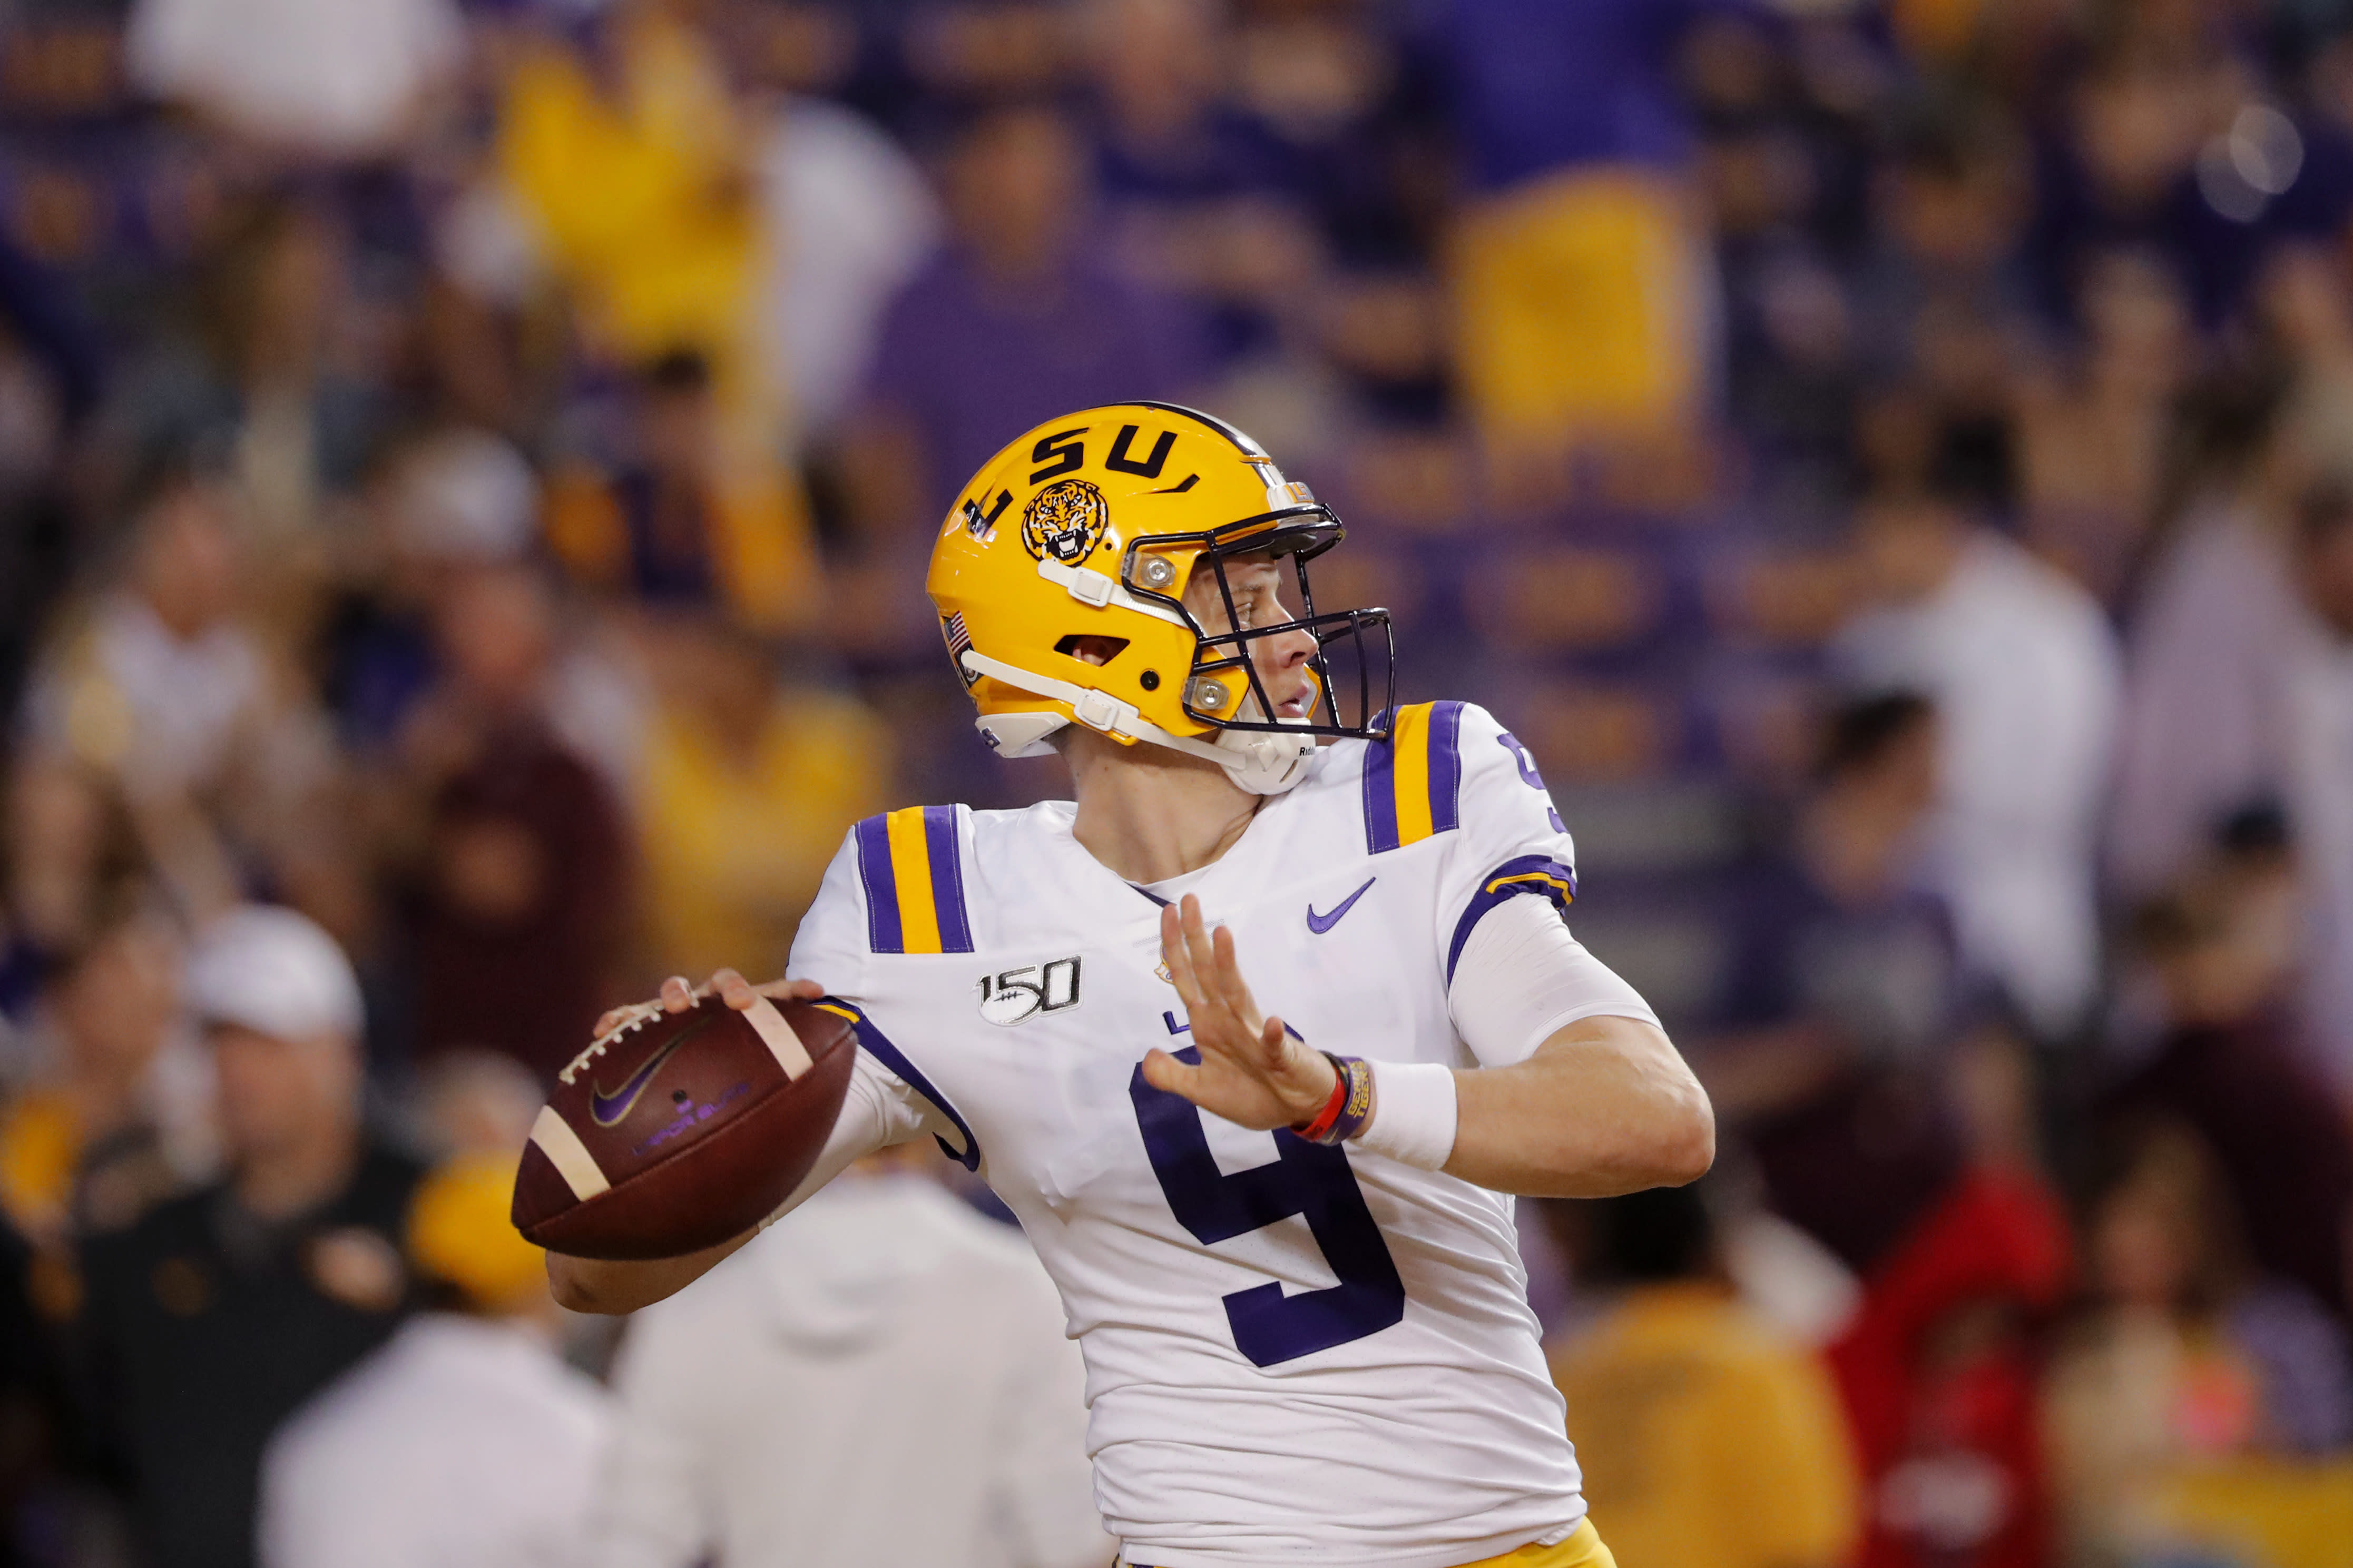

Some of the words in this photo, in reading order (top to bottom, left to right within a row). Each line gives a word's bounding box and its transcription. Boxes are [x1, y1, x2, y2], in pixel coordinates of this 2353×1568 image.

[963, 425, 1179, 538] LSU
[977, 955, 1083, 1024] 150
[1129, 1020, 1405, 1368] 9
